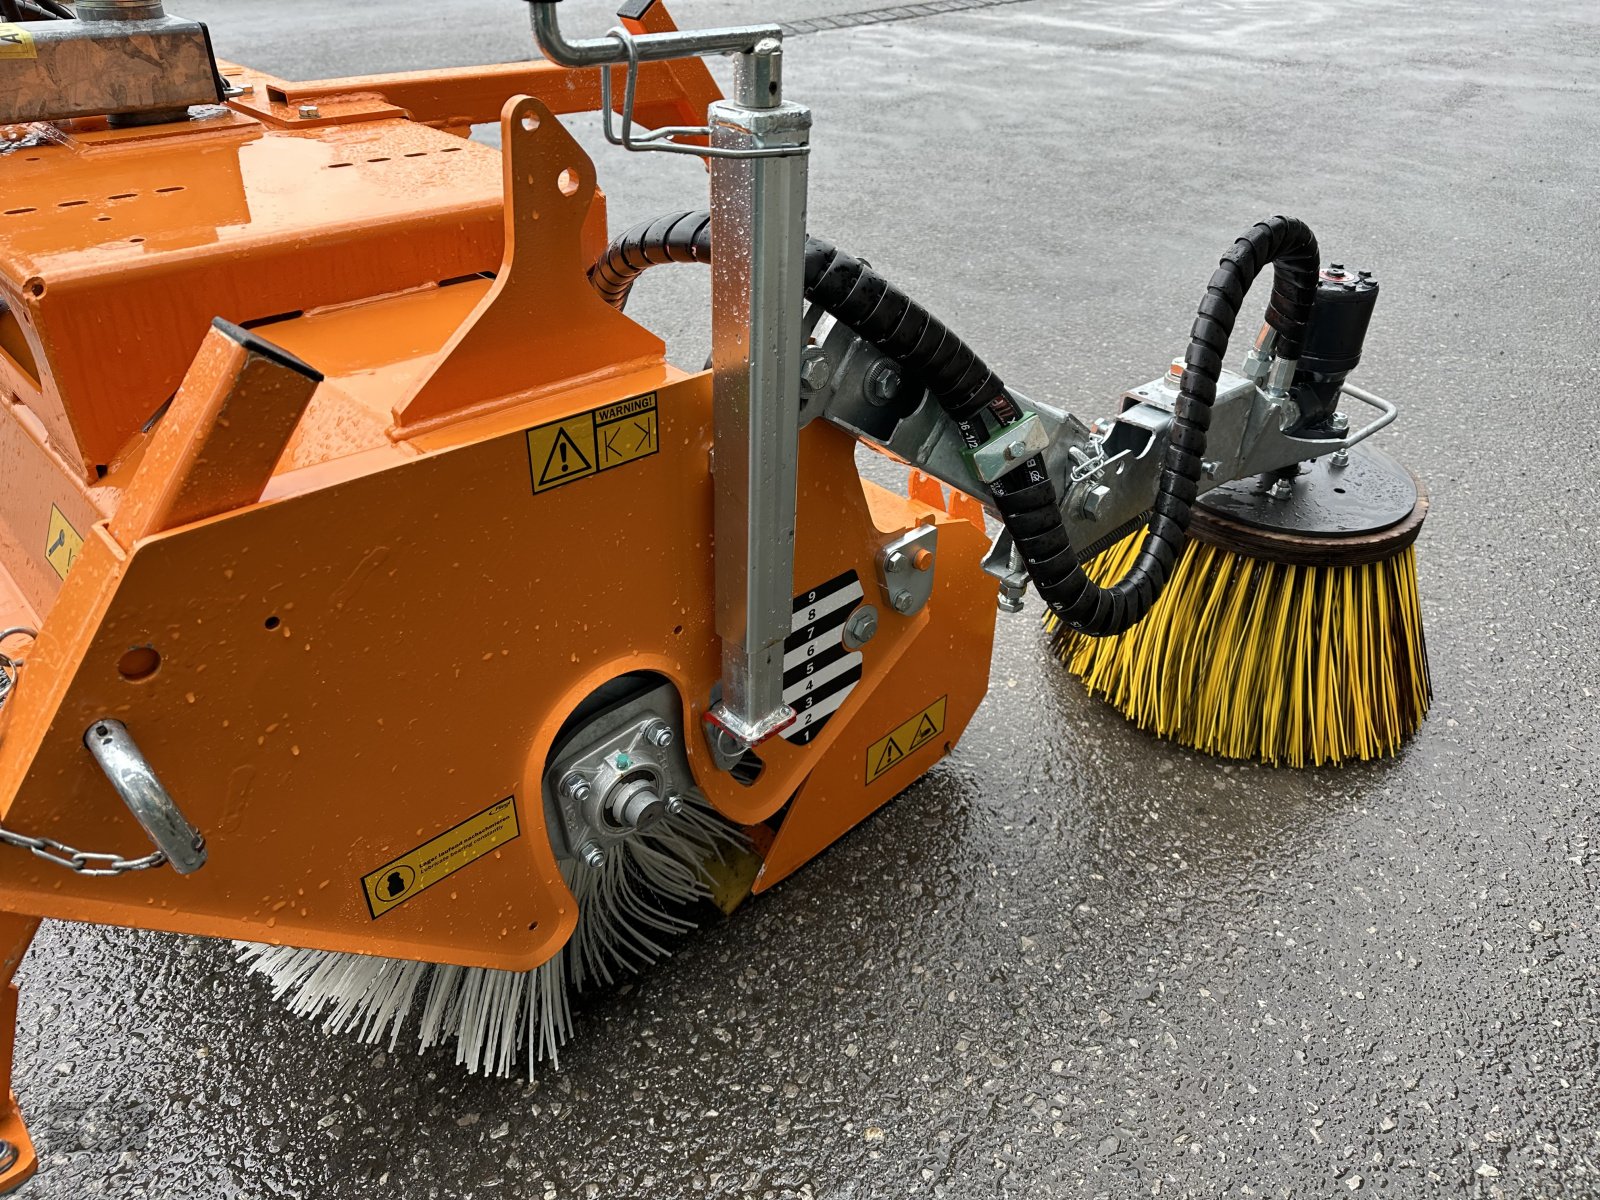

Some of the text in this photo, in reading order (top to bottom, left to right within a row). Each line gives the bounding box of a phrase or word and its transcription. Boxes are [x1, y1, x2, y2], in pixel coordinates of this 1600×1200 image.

[599, 397, 652, 420] WARNING!
[808, 591, 816, 603] 9
[808, 608, 816, 621] 8
[807, 627, 815, 639] 7
[807, 644, 815, 657] 6
[806, 662, 814, 675] 5
[805, 680, 814, 691] 4
[805, 697, 813, 709] 3
[804, 713, 812, 726] 2
[803, 731, 810, 742] 1
[419, 815, 511, 869] Lager laufend nachschmieren
[420, 825, 504, 874] Lubricate bearing constantly
